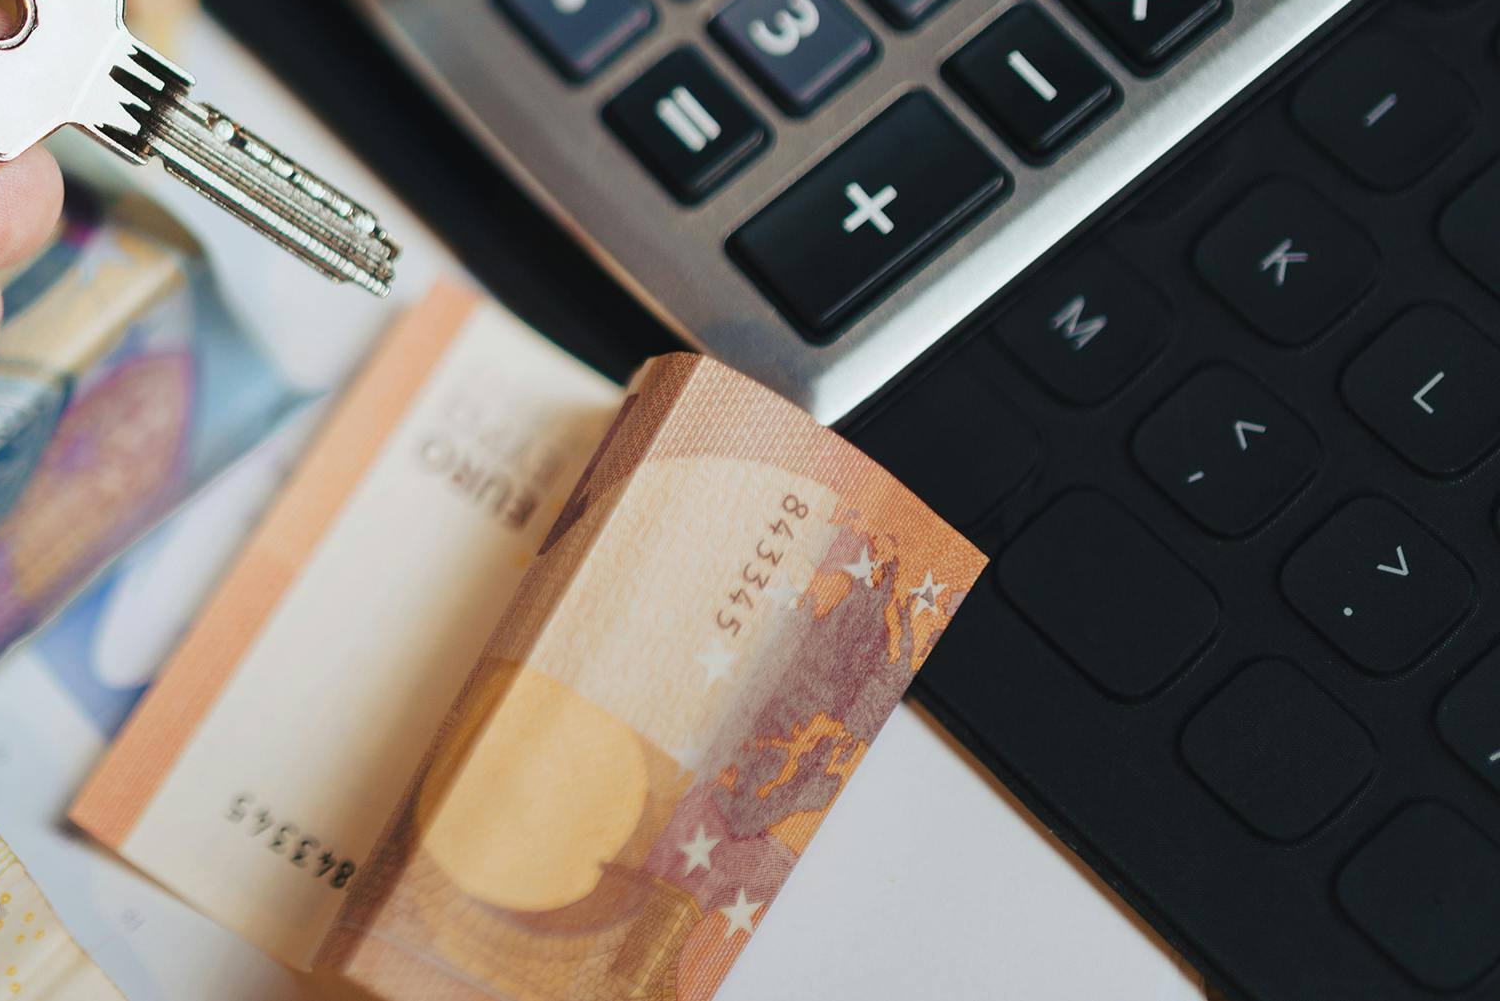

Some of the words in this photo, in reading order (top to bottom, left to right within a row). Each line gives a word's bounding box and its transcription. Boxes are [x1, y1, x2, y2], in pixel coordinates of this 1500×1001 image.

[1262, 240, 1307, 284] K
[1054, 297, 1106, 348] M
[1413, 372, 1444, 414] L
[417, 436, 539, 531] EURO
[716, 494, 809, 637] 843345
[226, 792, 357, 890] 843345
